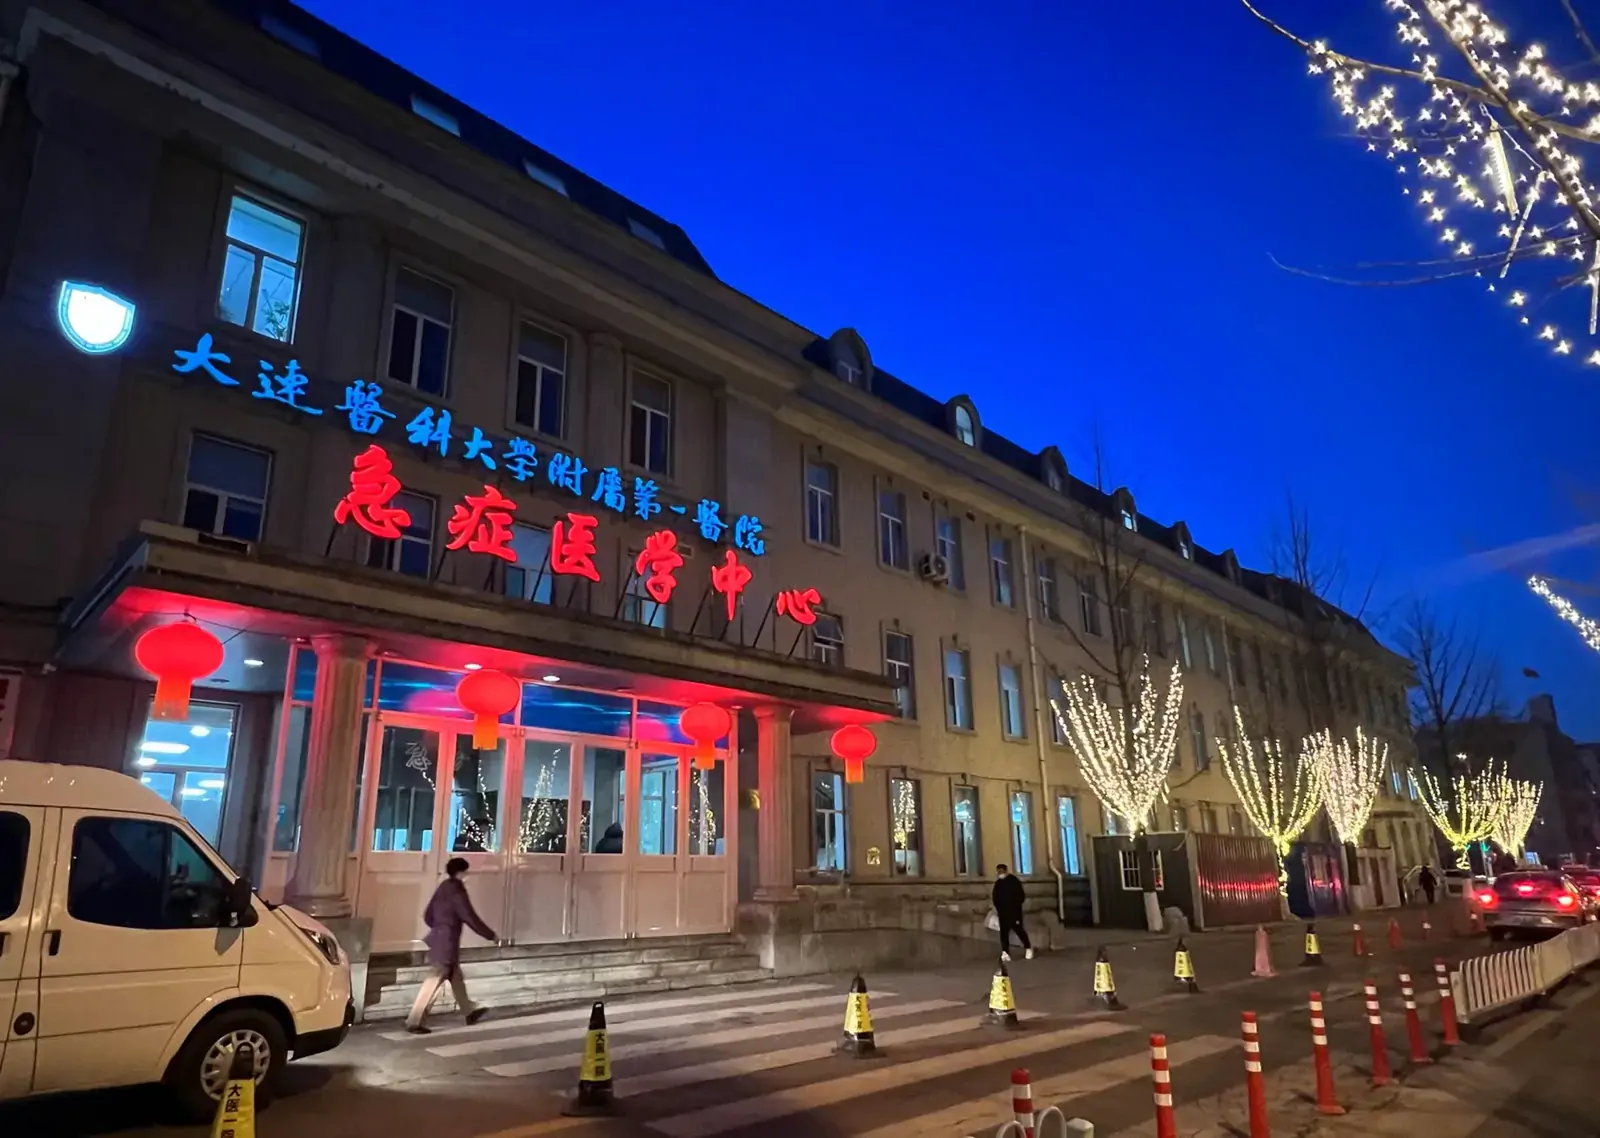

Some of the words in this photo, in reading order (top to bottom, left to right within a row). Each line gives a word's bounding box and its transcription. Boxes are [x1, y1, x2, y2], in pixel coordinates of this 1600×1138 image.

[334, 443, 822, 625] 急症医学中心
